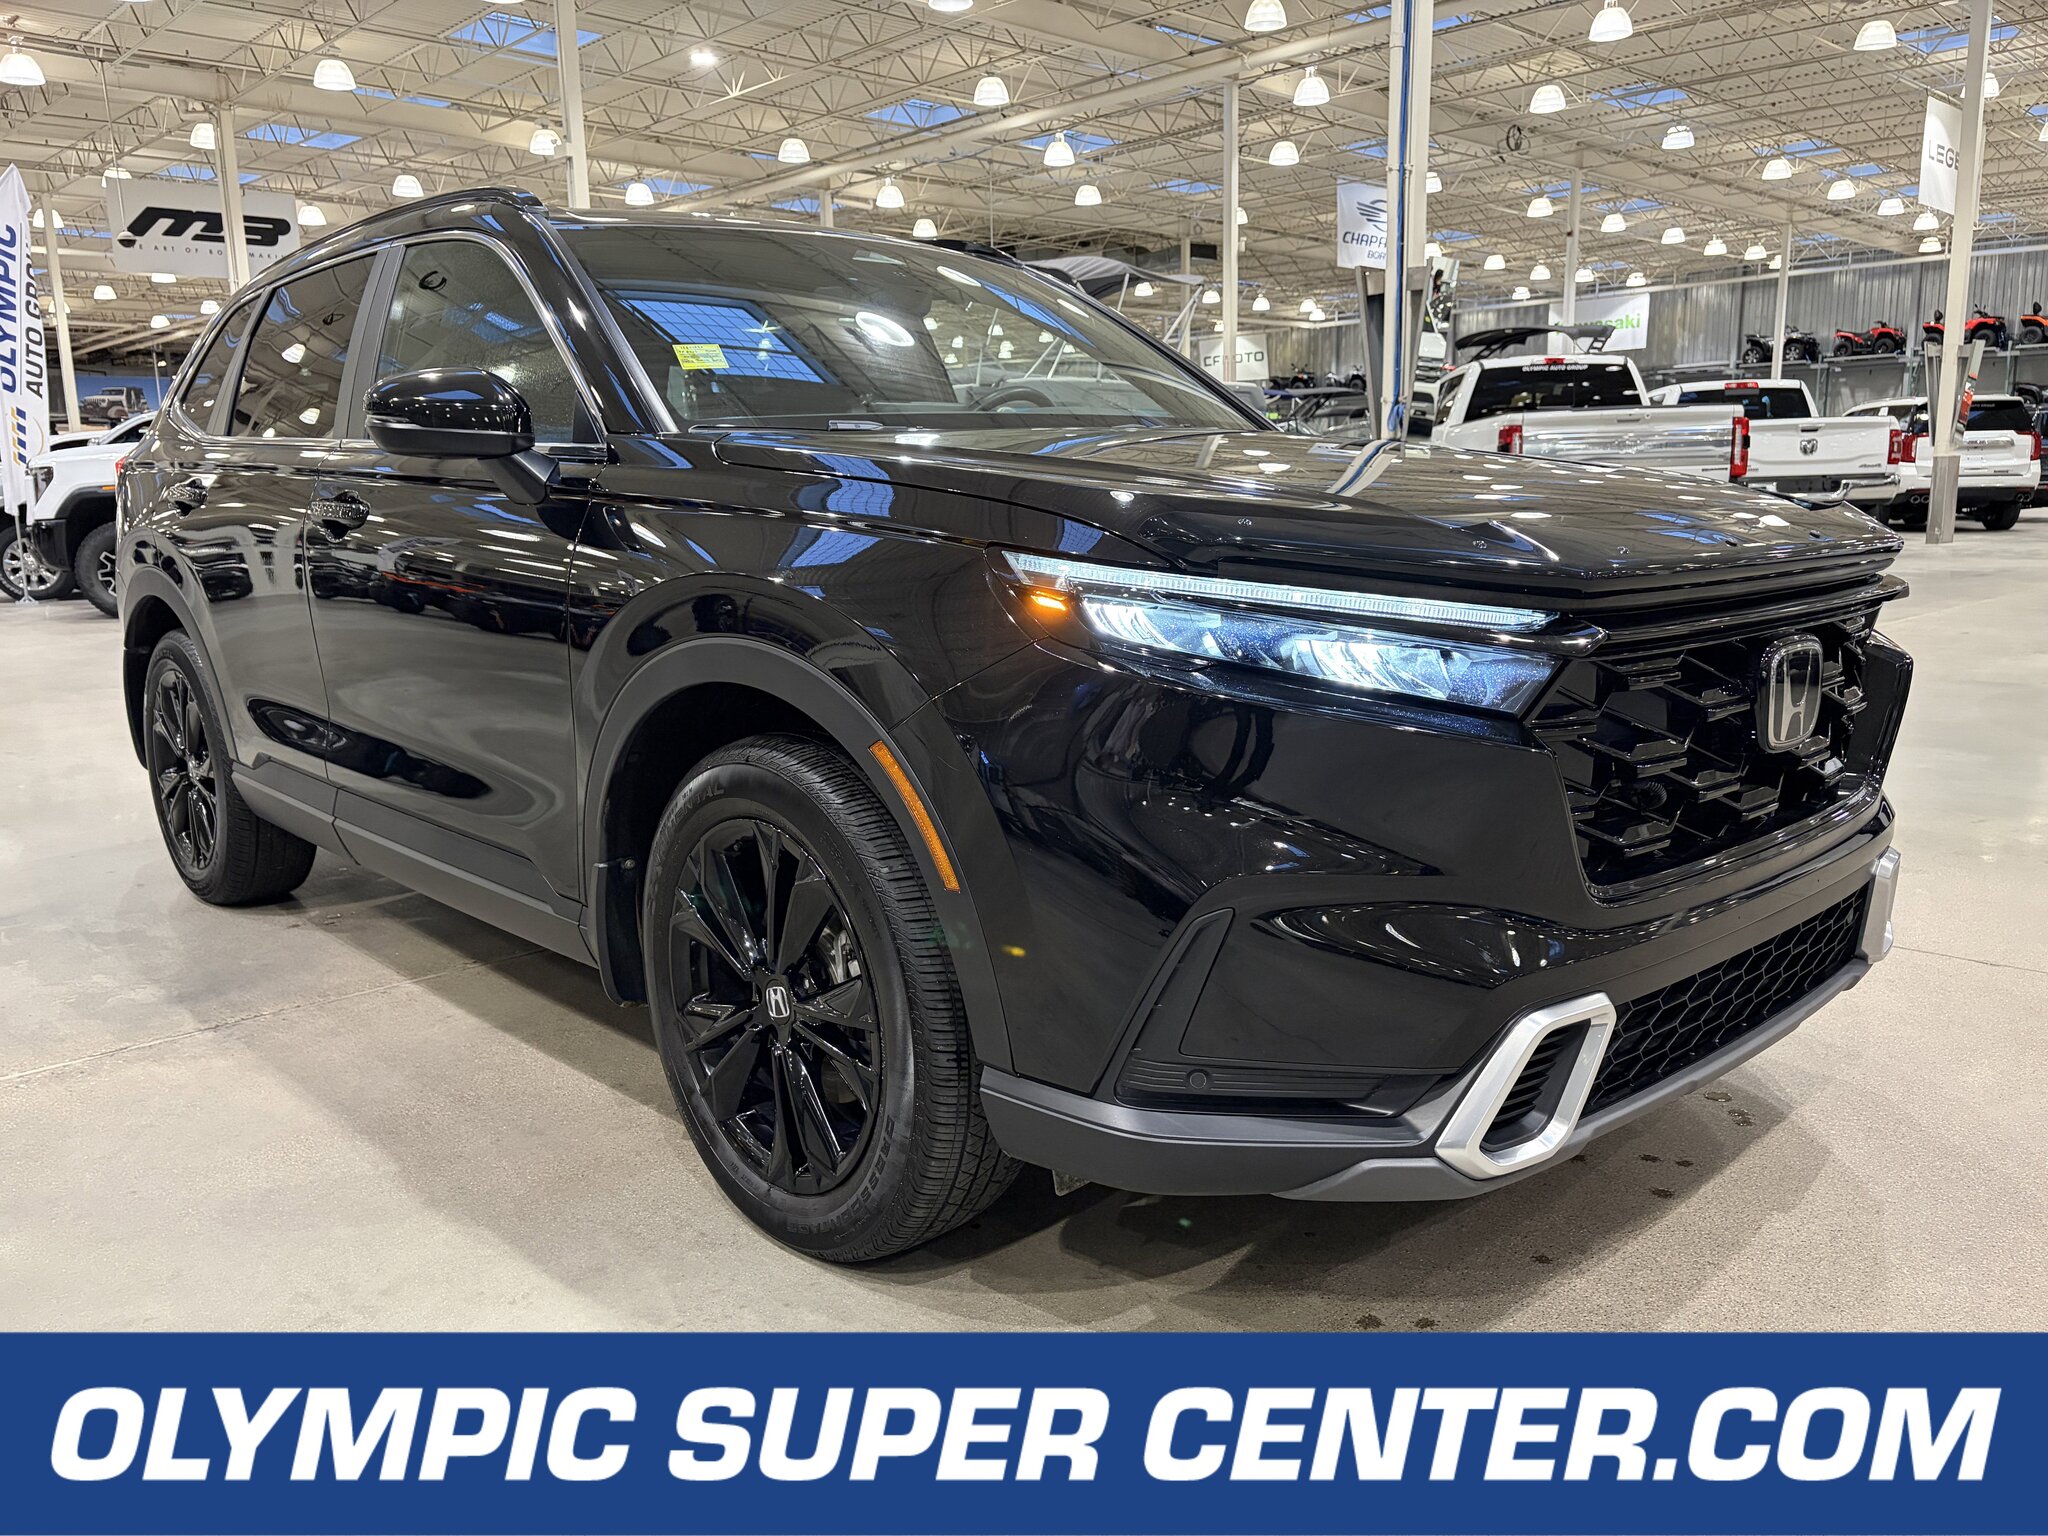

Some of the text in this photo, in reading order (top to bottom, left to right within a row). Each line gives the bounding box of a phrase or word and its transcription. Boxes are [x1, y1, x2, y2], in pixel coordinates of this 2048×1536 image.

[1928, 139, 1960, 171] LEGE
[1342, 231, 1387, 248] CHAPA
[248, 251, 286, 260] MAKI
[1367, 250, 1387, 260] BOA
[25, 324, 43, 399] AUTO
[1203, 351, 1265, 367] CFOTO
[1521, 364, 1549, 372] OLYMPIC
[1566, 363, 1588, 371] GROUP
